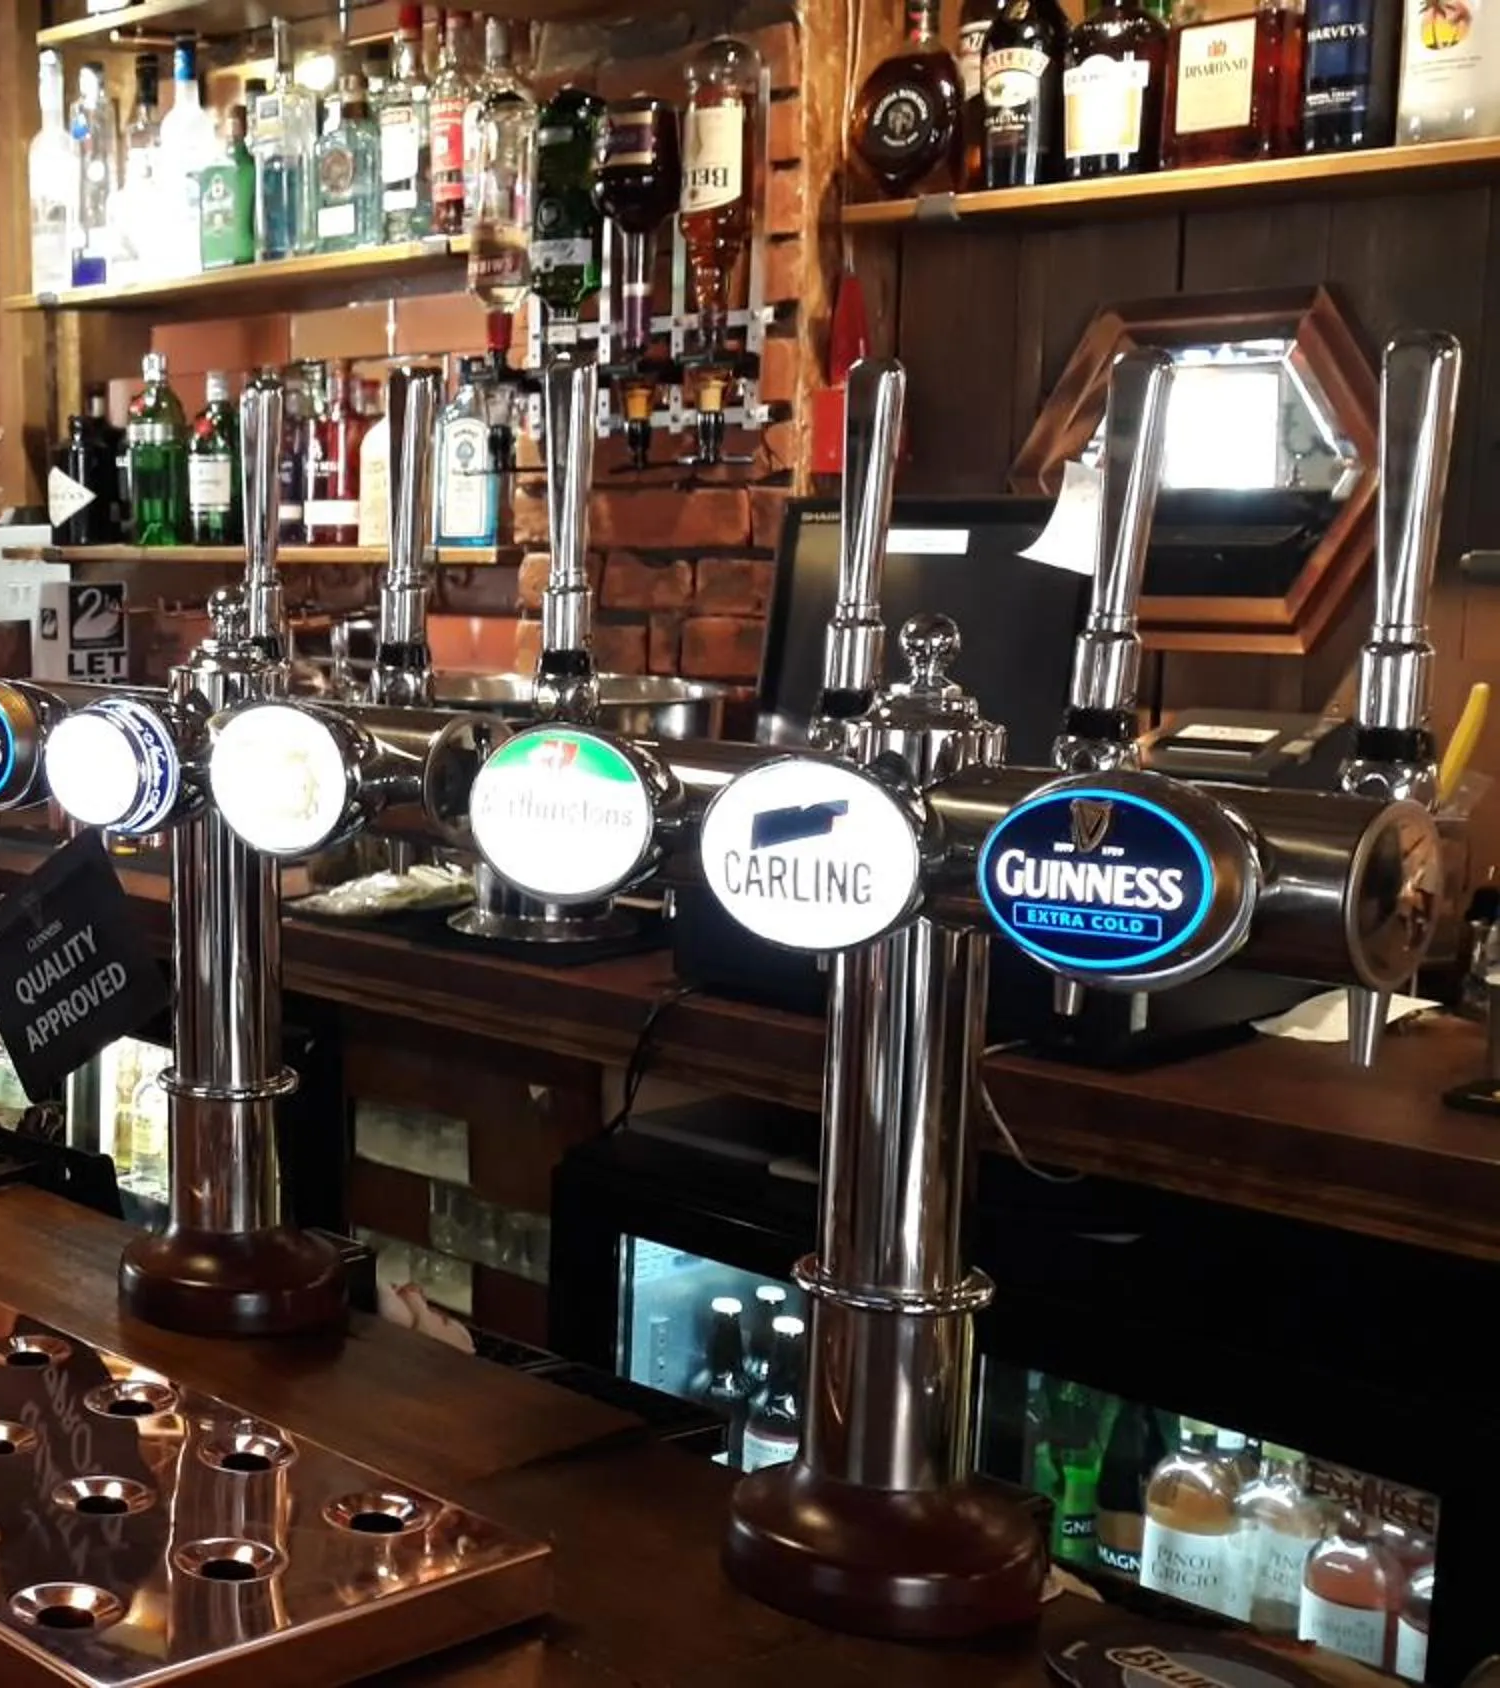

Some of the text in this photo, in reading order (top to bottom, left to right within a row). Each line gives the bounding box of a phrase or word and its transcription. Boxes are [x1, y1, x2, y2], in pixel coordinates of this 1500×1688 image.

[1307, 23, 1366, 43] HARVEYS
[67, 652, 127, 675] LET
[724, 850, 872, 904] CARLING
[996, 849, 1183, 910] GUINNESS
[1026, 909, 1144, 934] EXTRA COLD
[15, 924, 98, 1005] QUALITY
[26, 961, 128, 1054] APPROVED
[1156, 1543, 1213, 1571] PINOT
[1151, 1562, 1220, 1590] GRIGIO
